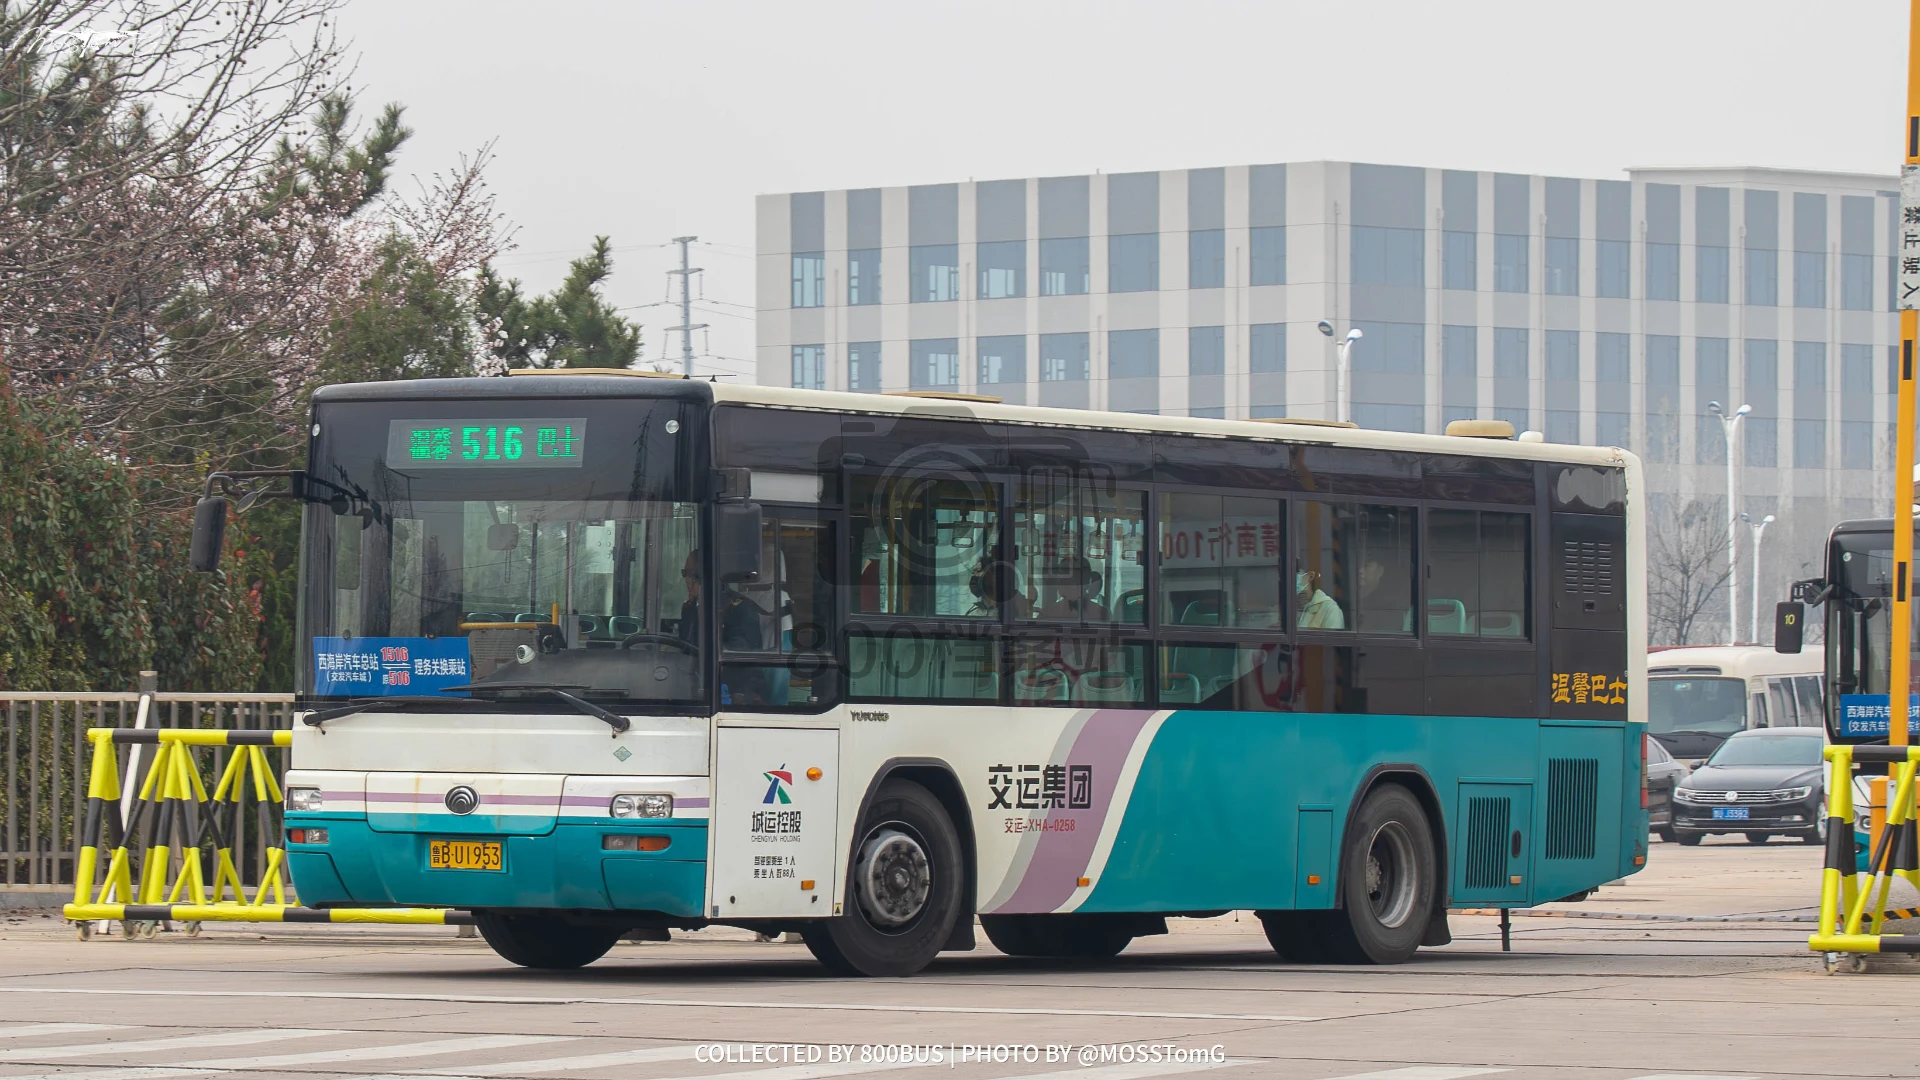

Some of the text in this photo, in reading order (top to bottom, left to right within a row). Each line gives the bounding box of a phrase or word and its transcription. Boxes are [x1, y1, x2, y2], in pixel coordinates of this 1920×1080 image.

[462, 427, 523, 460] 516
[537, 426, 580, 458] 巴士
[1784, 614, 1796, 625] 10
[318, 653, 379, 671] 西海岸汽车总站
[380, 647, 409, 662] 1516
[414, 658, 466, 676] 理务关换乘站
[1551, 672, 1628, 705] 温馨巴士
[850, 709, 890, 722] YUTONG
[988, 764, 1092, 810] 交运集团
[751, 811, 801, 833] 城运控股
[1004, 818, 1076, 833] 交运-XHA-0258
[751, 835, 801, 843] CHENGYUN HOLDING
